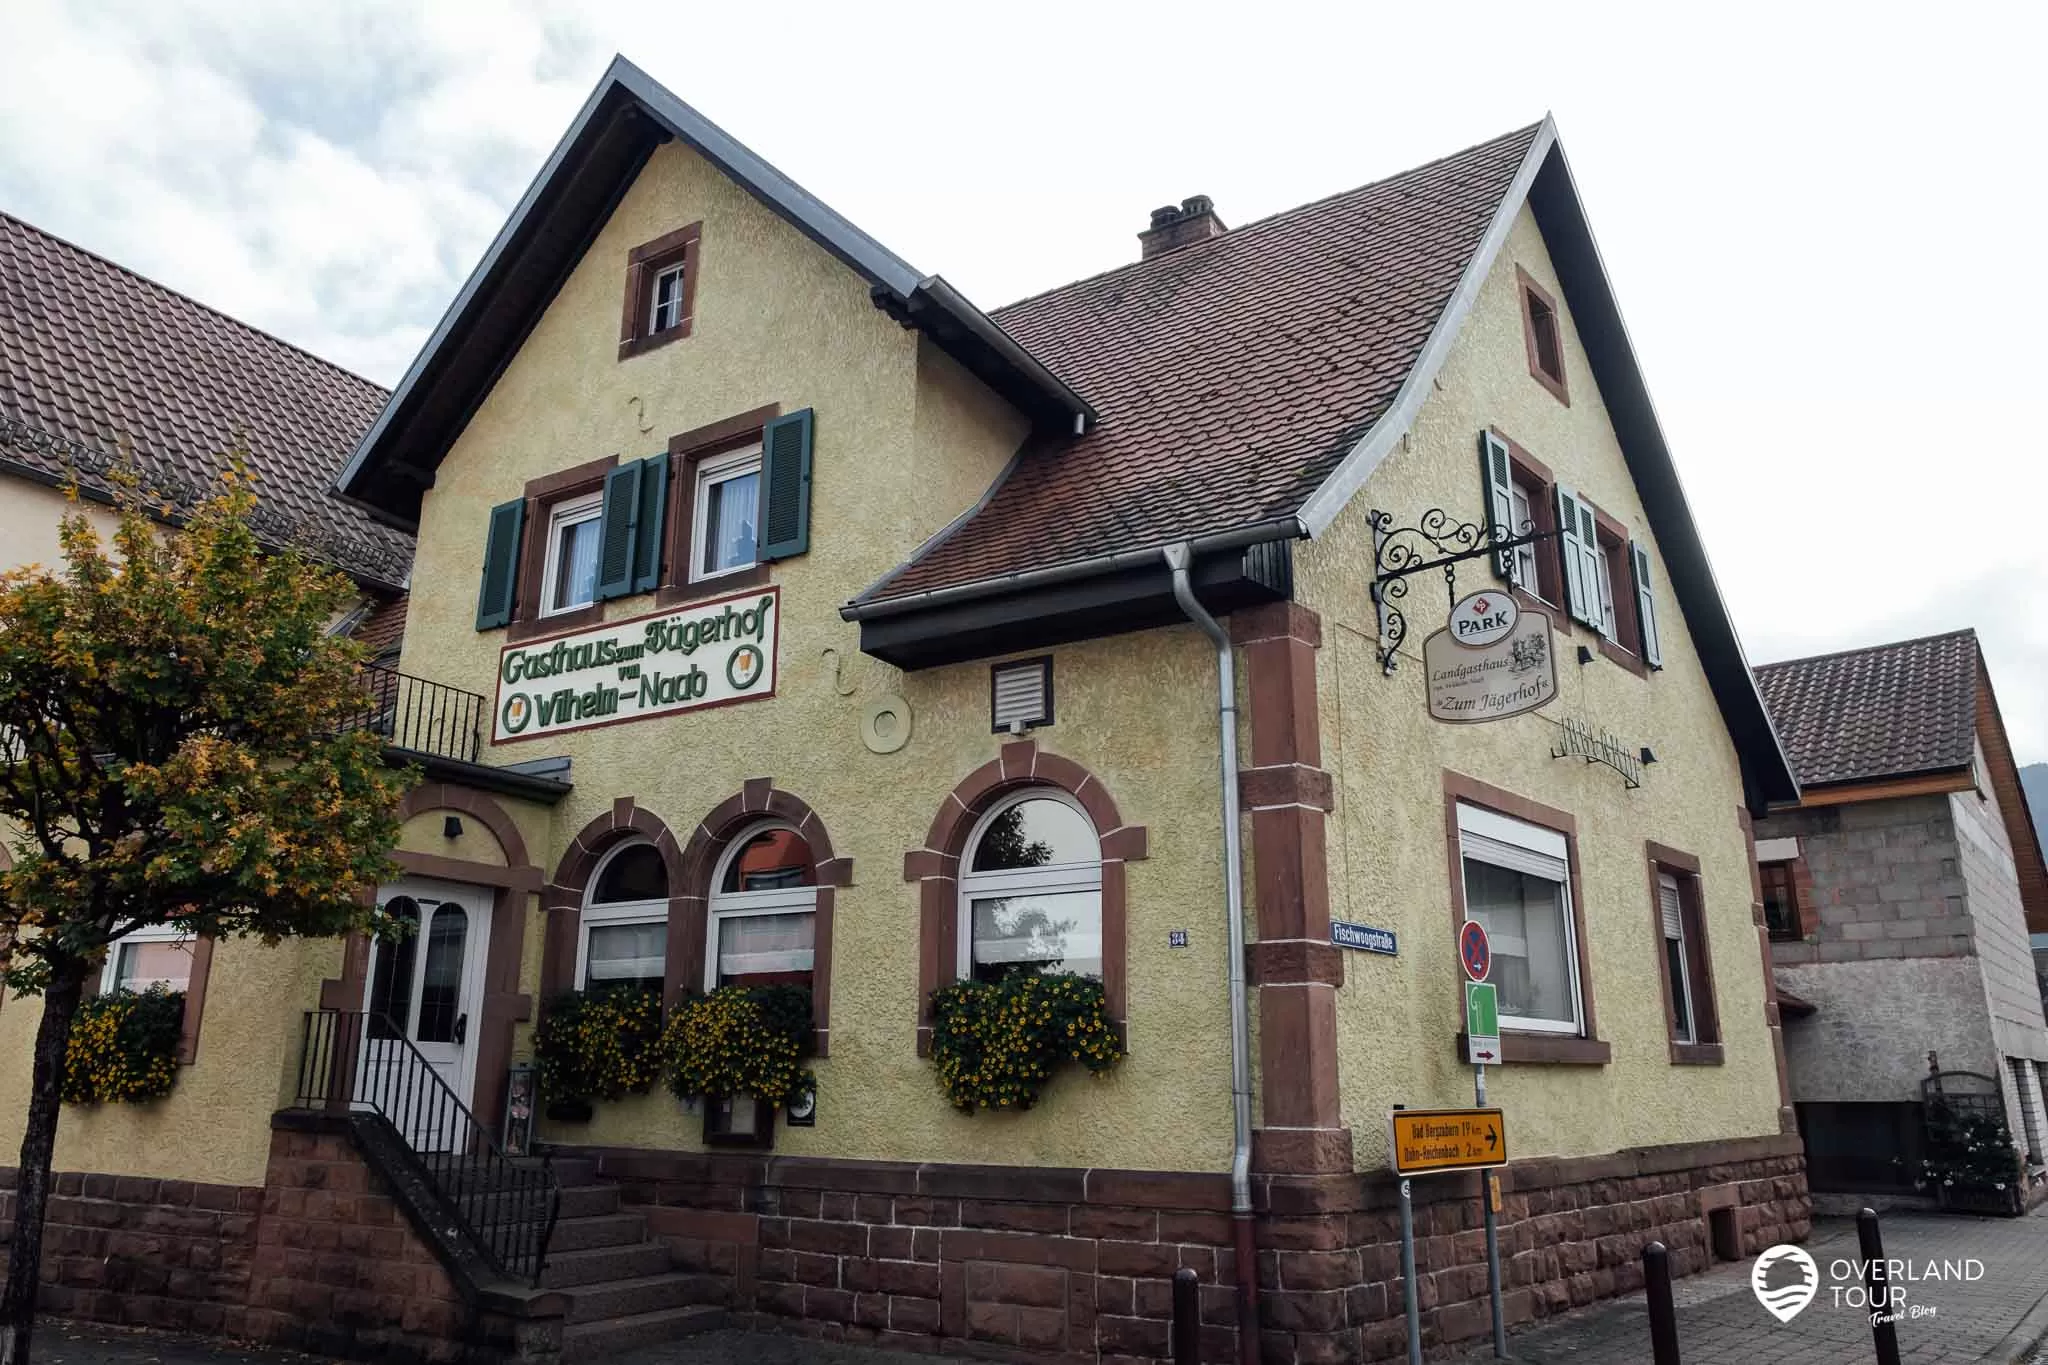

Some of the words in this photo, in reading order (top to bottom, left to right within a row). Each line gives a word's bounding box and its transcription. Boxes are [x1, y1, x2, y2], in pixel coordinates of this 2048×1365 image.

[1458, 611, 1508, 635] PARK
[503, 638, 618, 684] Gasthaus
[616, 643, 645, 662] zum
[644, 595, 772, 655] Jägerhof
[1432, 658, 1509, 682] Landgasthaus
[1334, 924, 1393, 950] Fischwoogstraße
[1462, 1121, 1471, 1137] 19
[1466, 1142, 1472, 1157] 2
